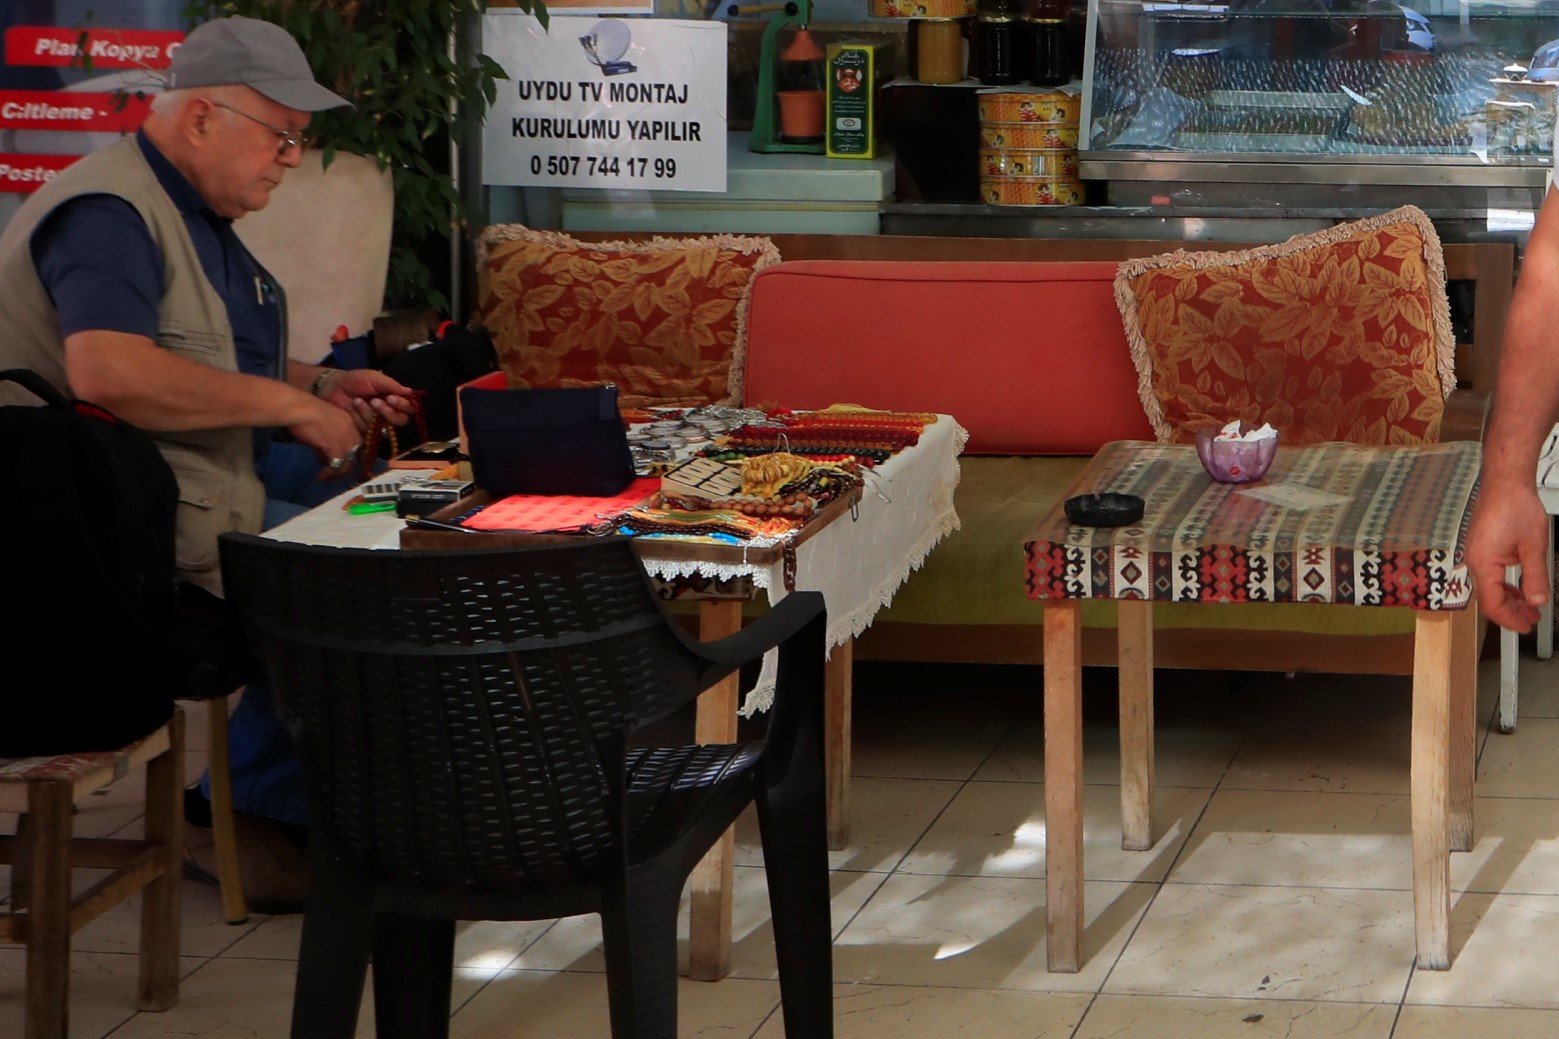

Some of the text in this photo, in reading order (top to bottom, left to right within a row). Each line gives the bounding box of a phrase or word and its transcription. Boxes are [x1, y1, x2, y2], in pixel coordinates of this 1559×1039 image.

[90, 39, 160, 62] Kopya
[519, 81, 689, 104] UYDU TV MONTAJ
[512, 117, 702, 142] KURULUMU YAPILIR
[530, 155, 677, 179] 0 507 744 17 99
